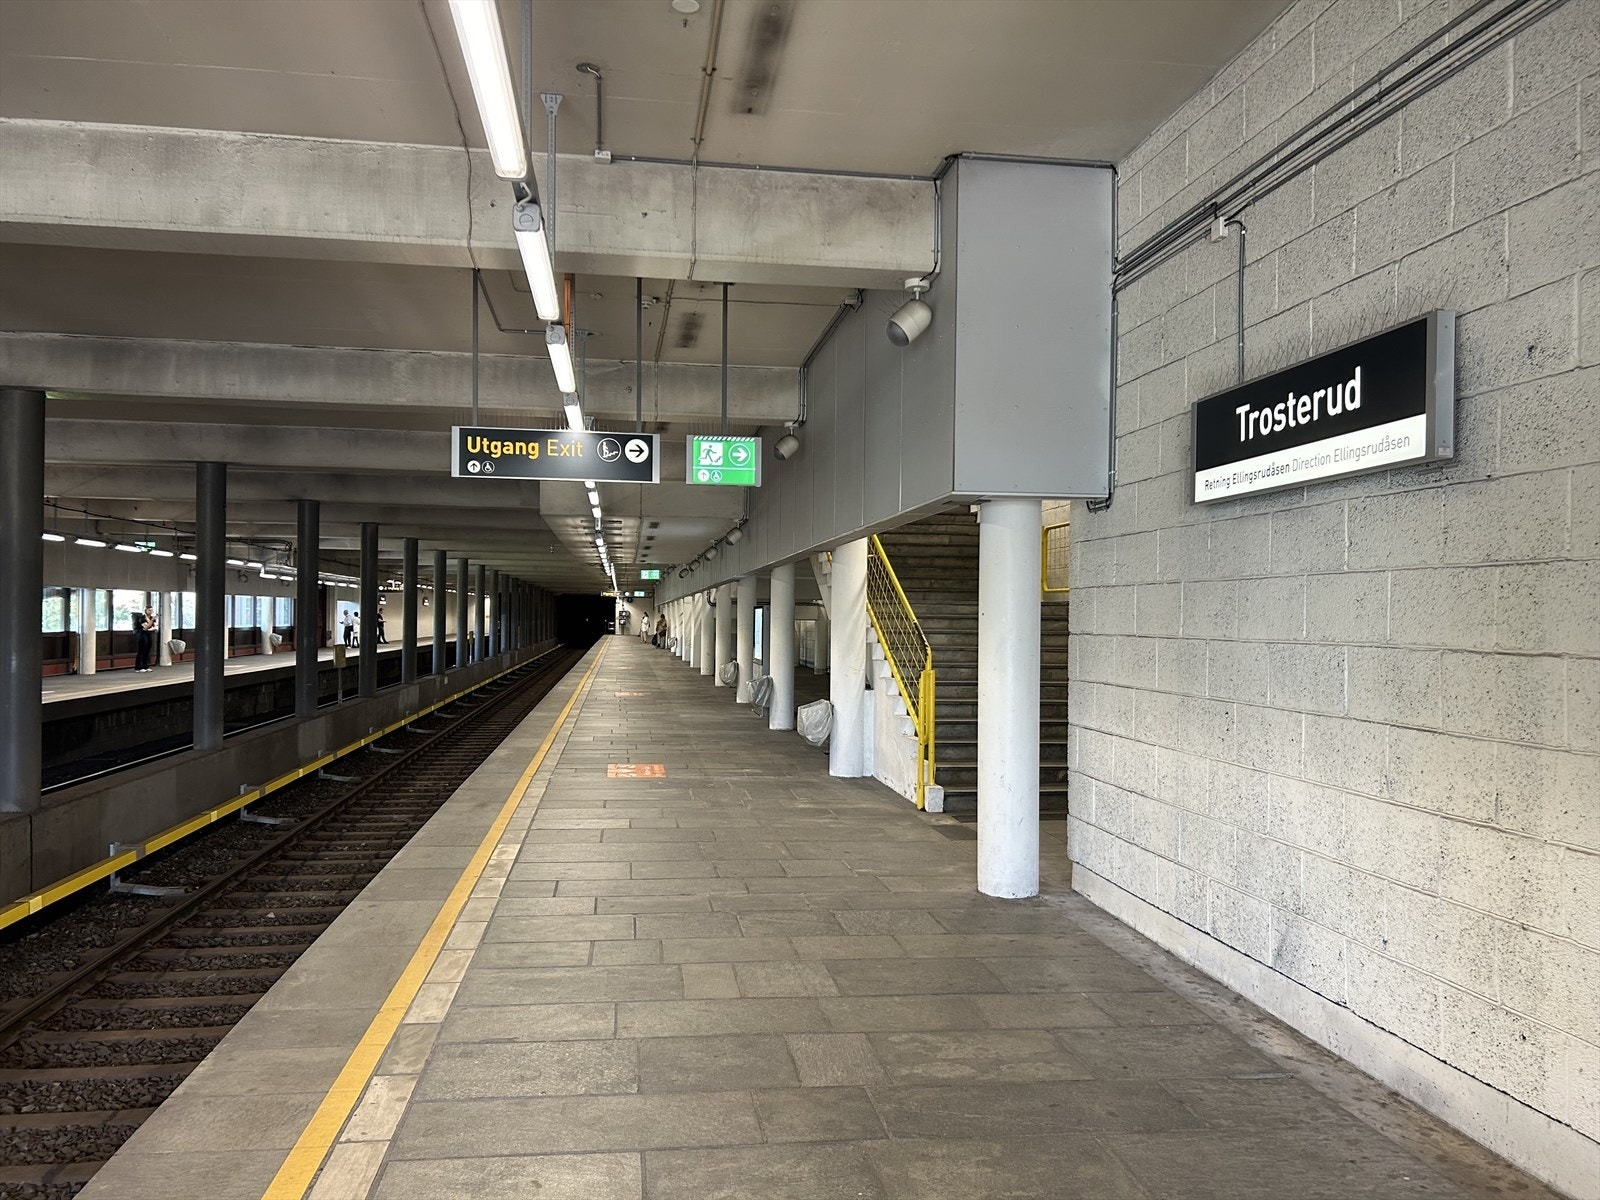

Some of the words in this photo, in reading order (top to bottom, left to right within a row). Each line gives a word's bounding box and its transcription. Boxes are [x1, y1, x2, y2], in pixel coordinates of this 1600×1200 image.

[1235, 365, 1361, 442] Trosterud
[467, 436, 539, 460] Utgang
[547, 439, 583, 457] Exit
[1204, 475, 1231, 491] Retning
[1232, 461, 1290, 485] Ellingsrudåsen
[1292, 452, 1331, 472] Direction
[1334, 435, 1410, 463] Ellingsrudåsen
